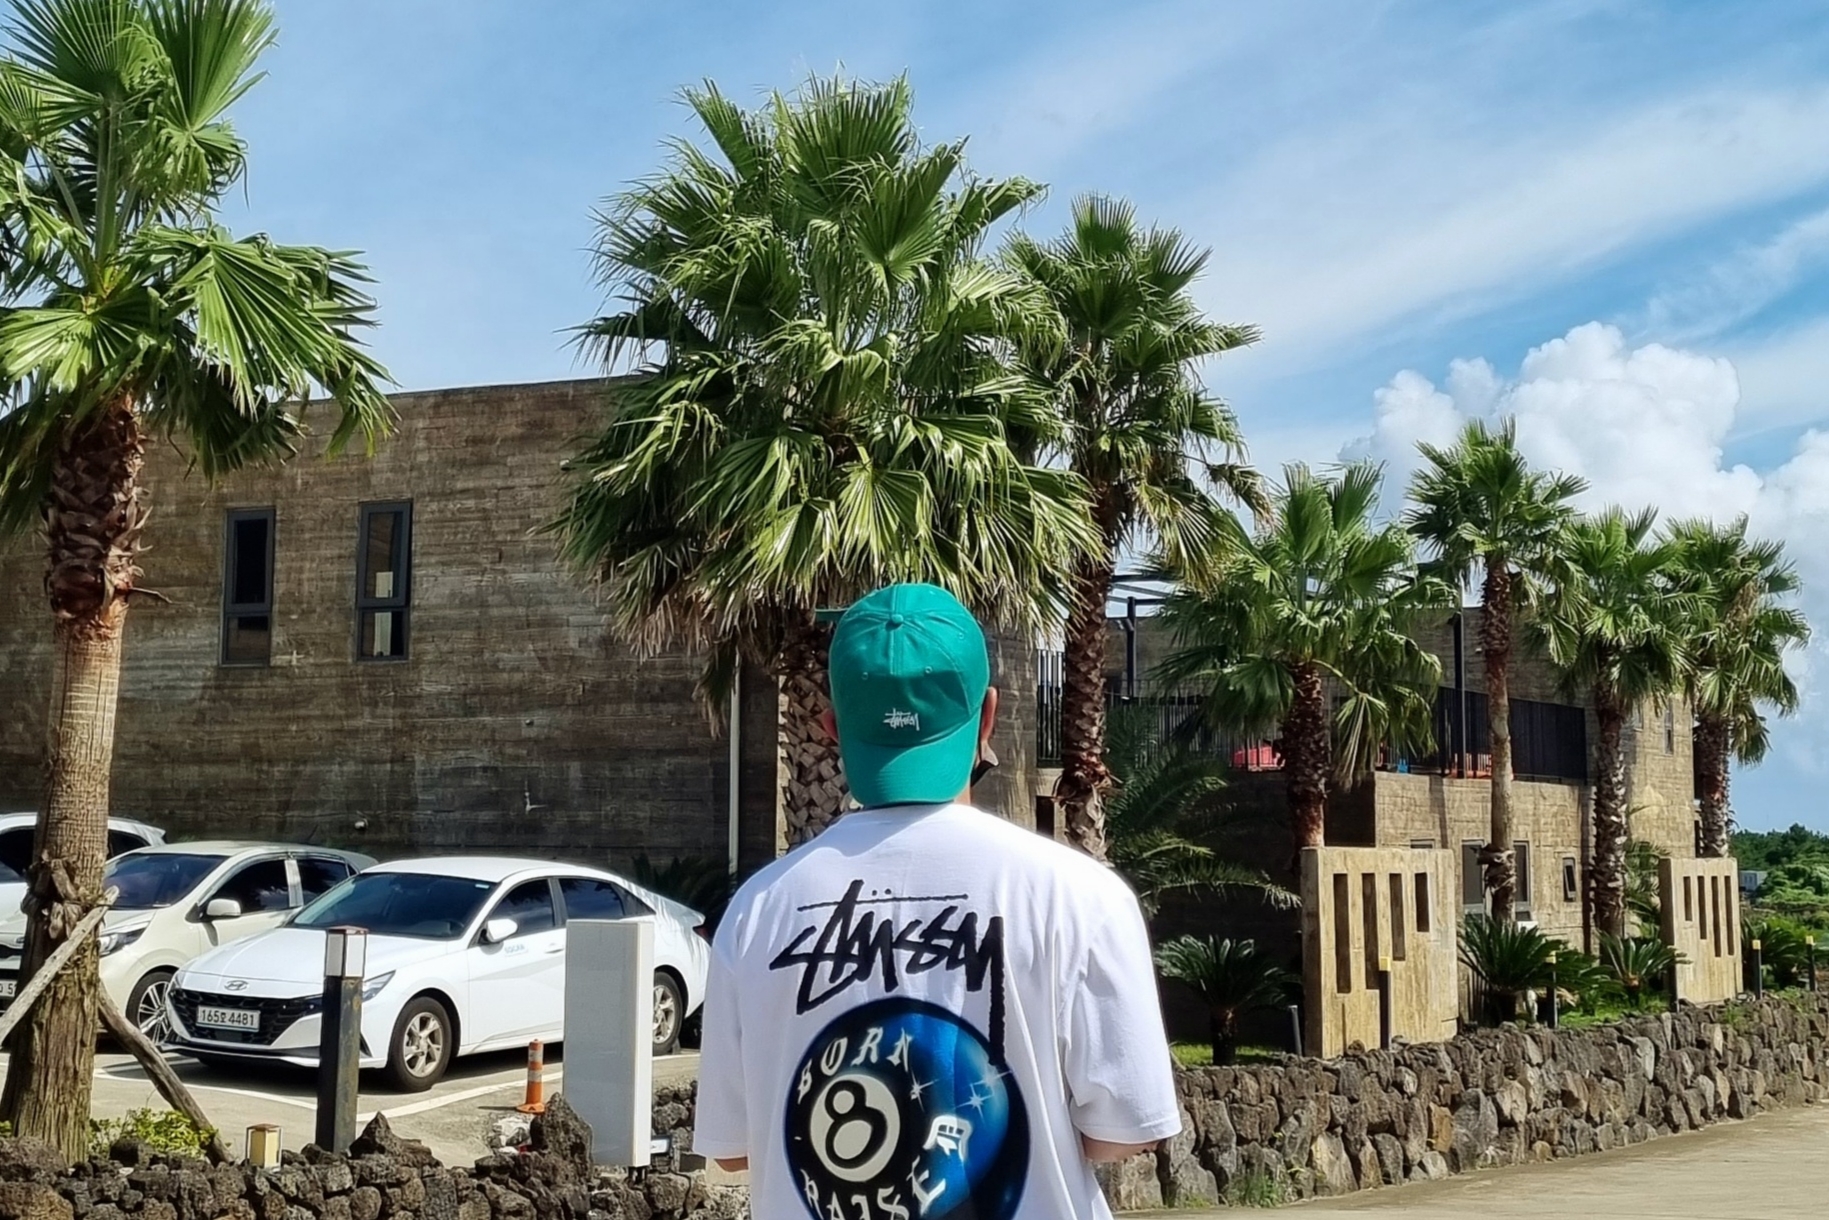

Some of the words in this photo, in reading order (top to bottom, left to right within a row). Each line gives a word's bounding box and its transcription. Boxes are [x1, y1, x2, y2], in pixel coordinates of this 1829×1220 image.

[228, 1012, 254, 1026] 4481
[797, 1027, 914, 1105] BORN
[824, 1080, 888, 1170] 8
